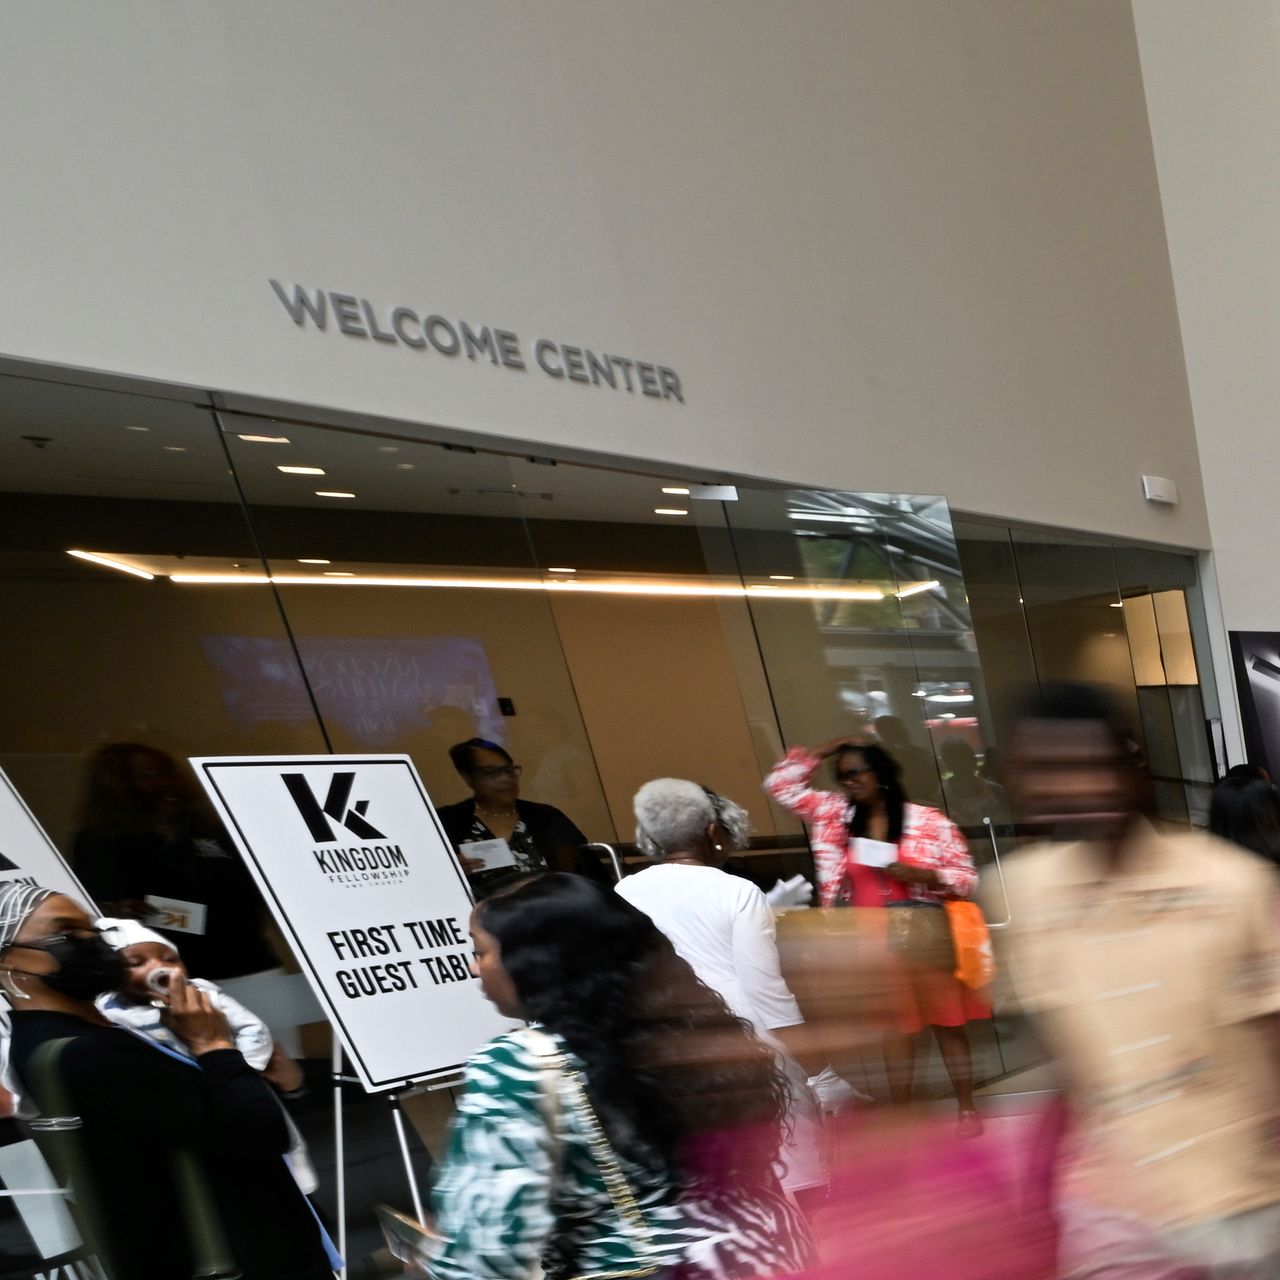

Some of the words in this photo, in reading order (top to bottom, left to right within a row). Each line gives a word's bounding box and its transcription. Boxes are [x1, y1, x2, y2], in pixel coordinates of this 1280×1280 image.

[270, 279, 525, 370] WELCOME
[534, 339, 686, 403] CENTER
[313, 845, 408, 874] KINGDOM
[329, 869, 410, 884] FELLOWSHIP
[326, 923, 402, 960] FIRST
[404, 917, 467, 950] TIME
[335, 961, 419, 999] GUEST
[420, 951, 481, 988] TABL
